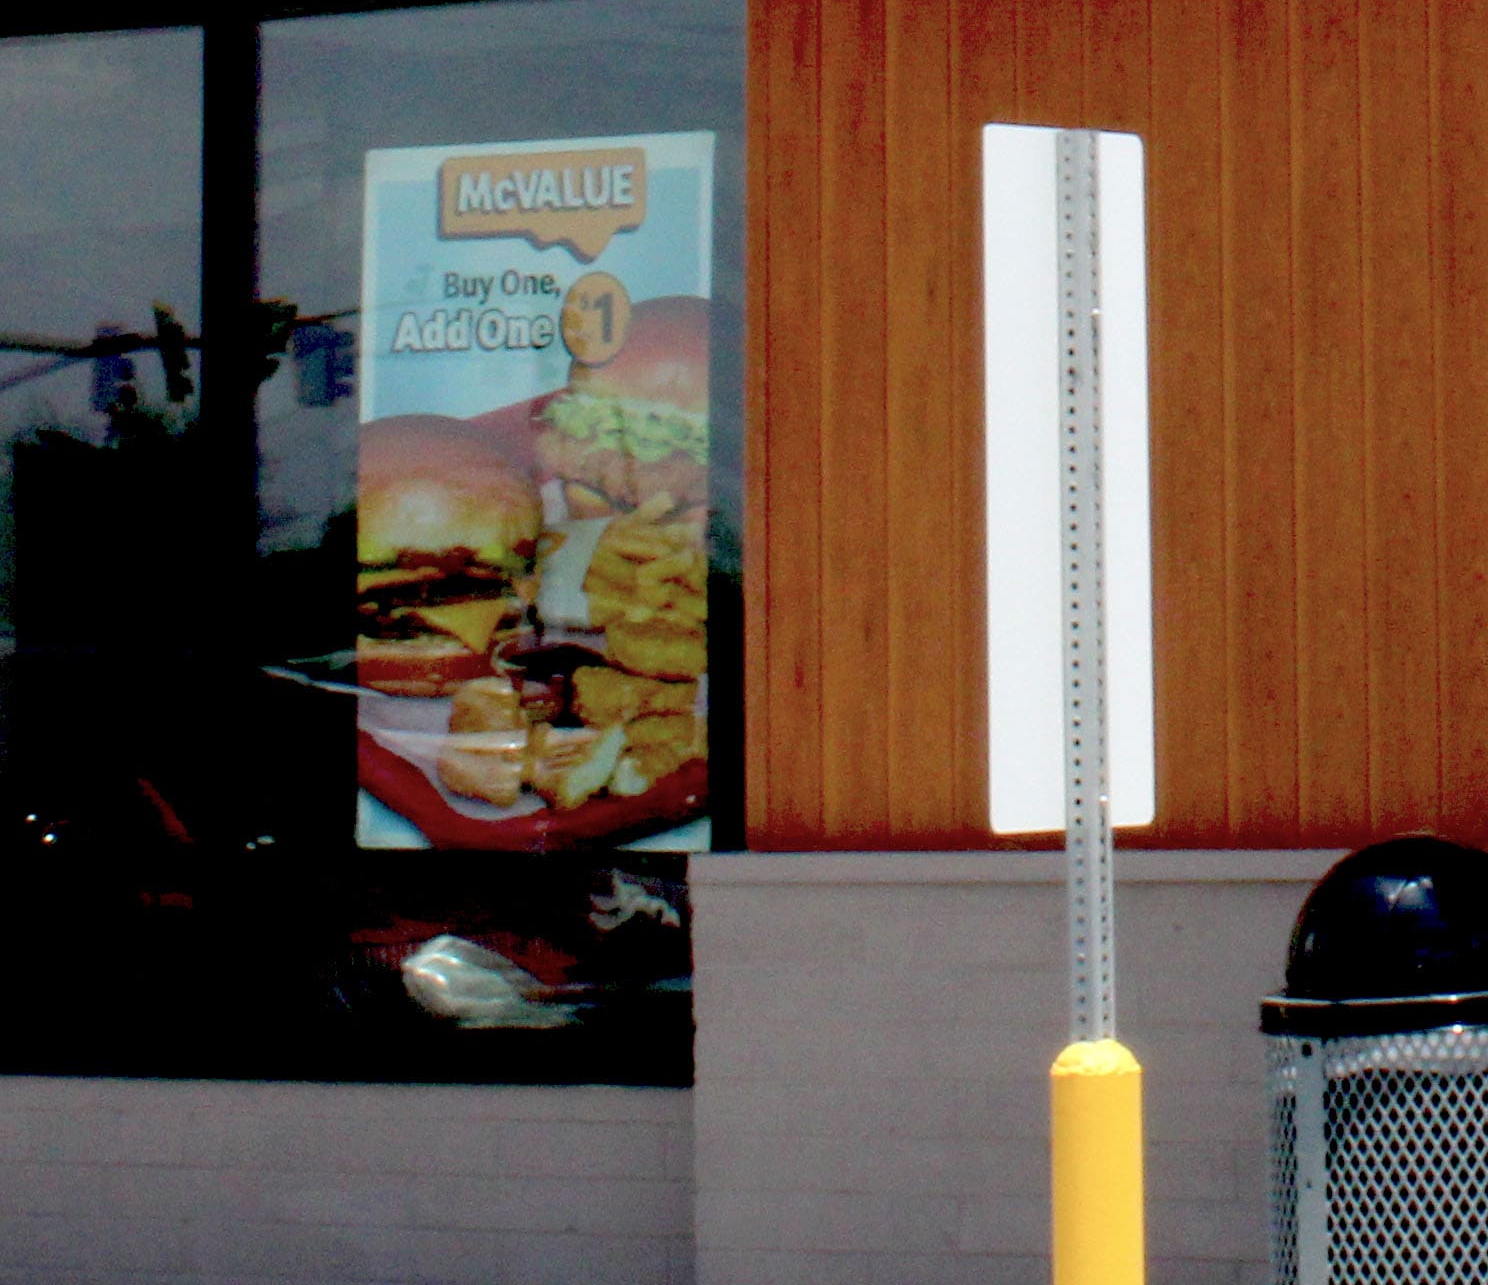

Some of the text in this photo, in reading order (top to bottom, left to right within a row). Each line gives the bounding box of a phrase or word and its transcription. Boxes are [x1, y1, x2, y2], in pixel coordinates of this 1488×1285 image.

[456, 164, 636, 214] McVALUE
[443, 269, 561, 305] Buy One,
[392, 308, 474, 353] Add
[475, 309, 557, 352] One
